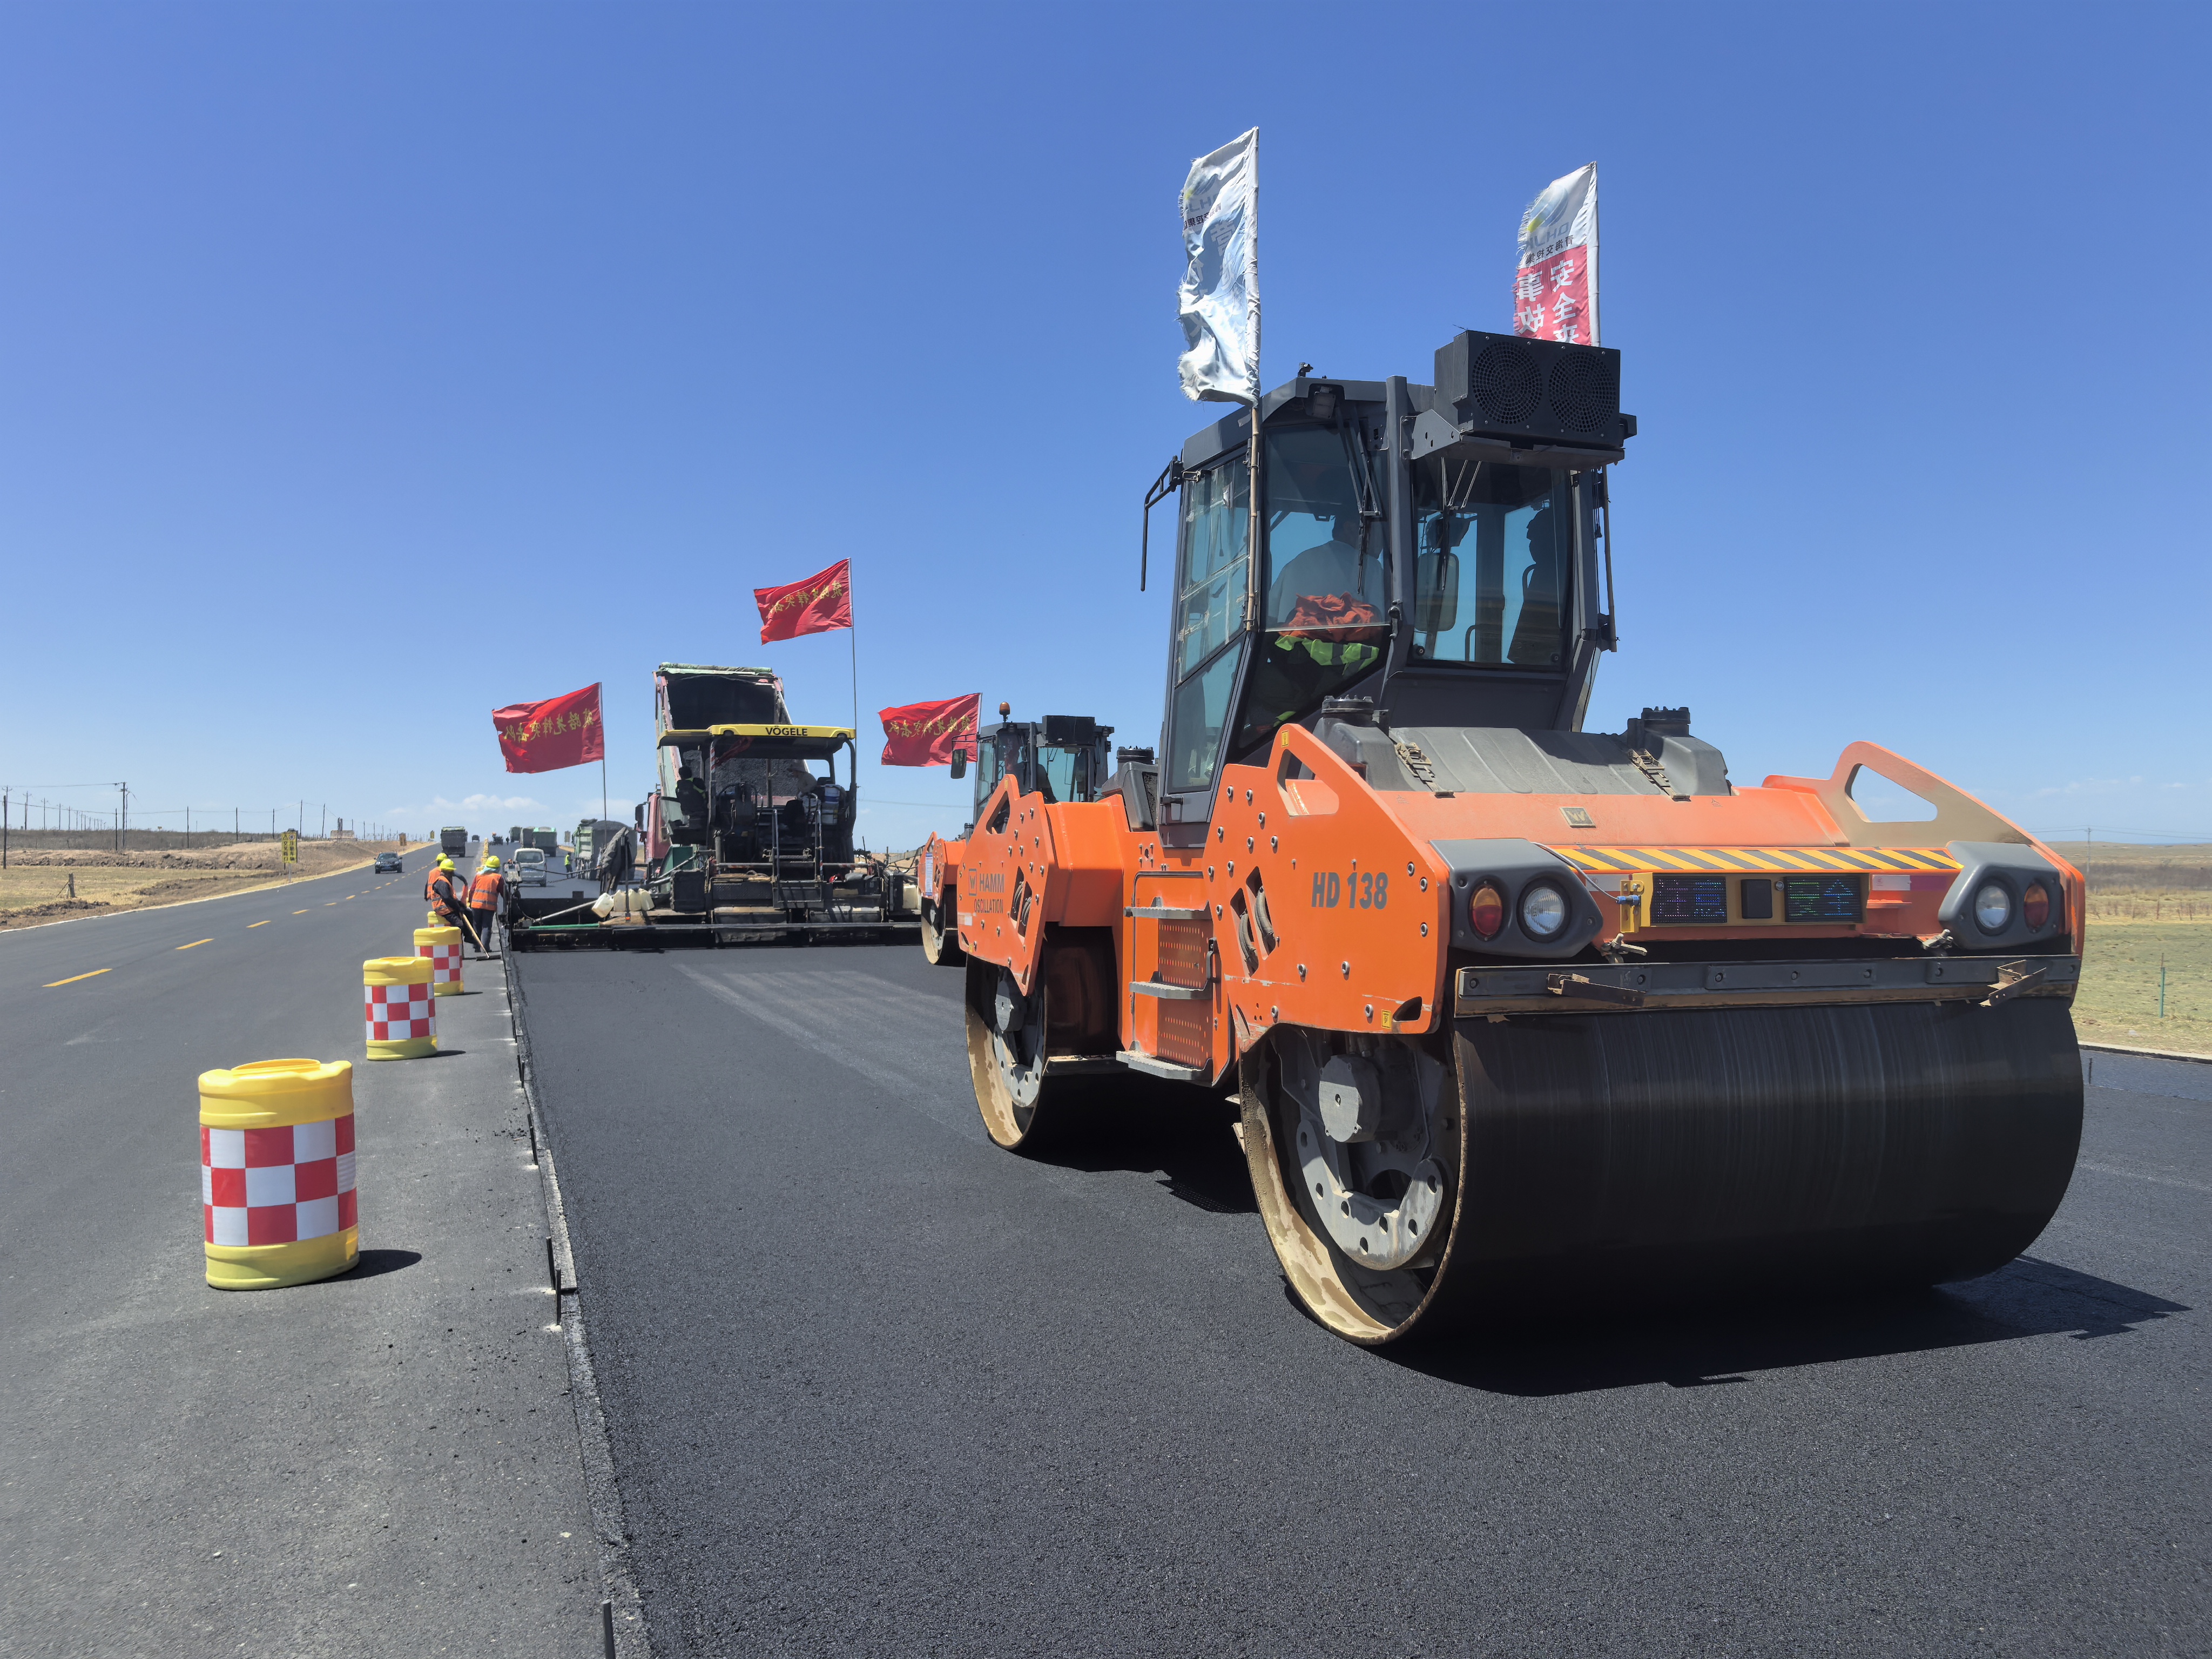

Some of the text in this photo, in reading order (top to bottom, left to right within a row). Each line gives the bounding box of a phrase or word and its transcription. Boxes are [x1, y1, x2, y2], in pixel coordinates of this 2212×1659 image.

[765, 726, 808, 736] VÖGELE
[979, 873, 1004, 893] HAMM
[1311, 872, 1388, 910] HD 138
[974, 899, 1003, 914] OSCILLATION
